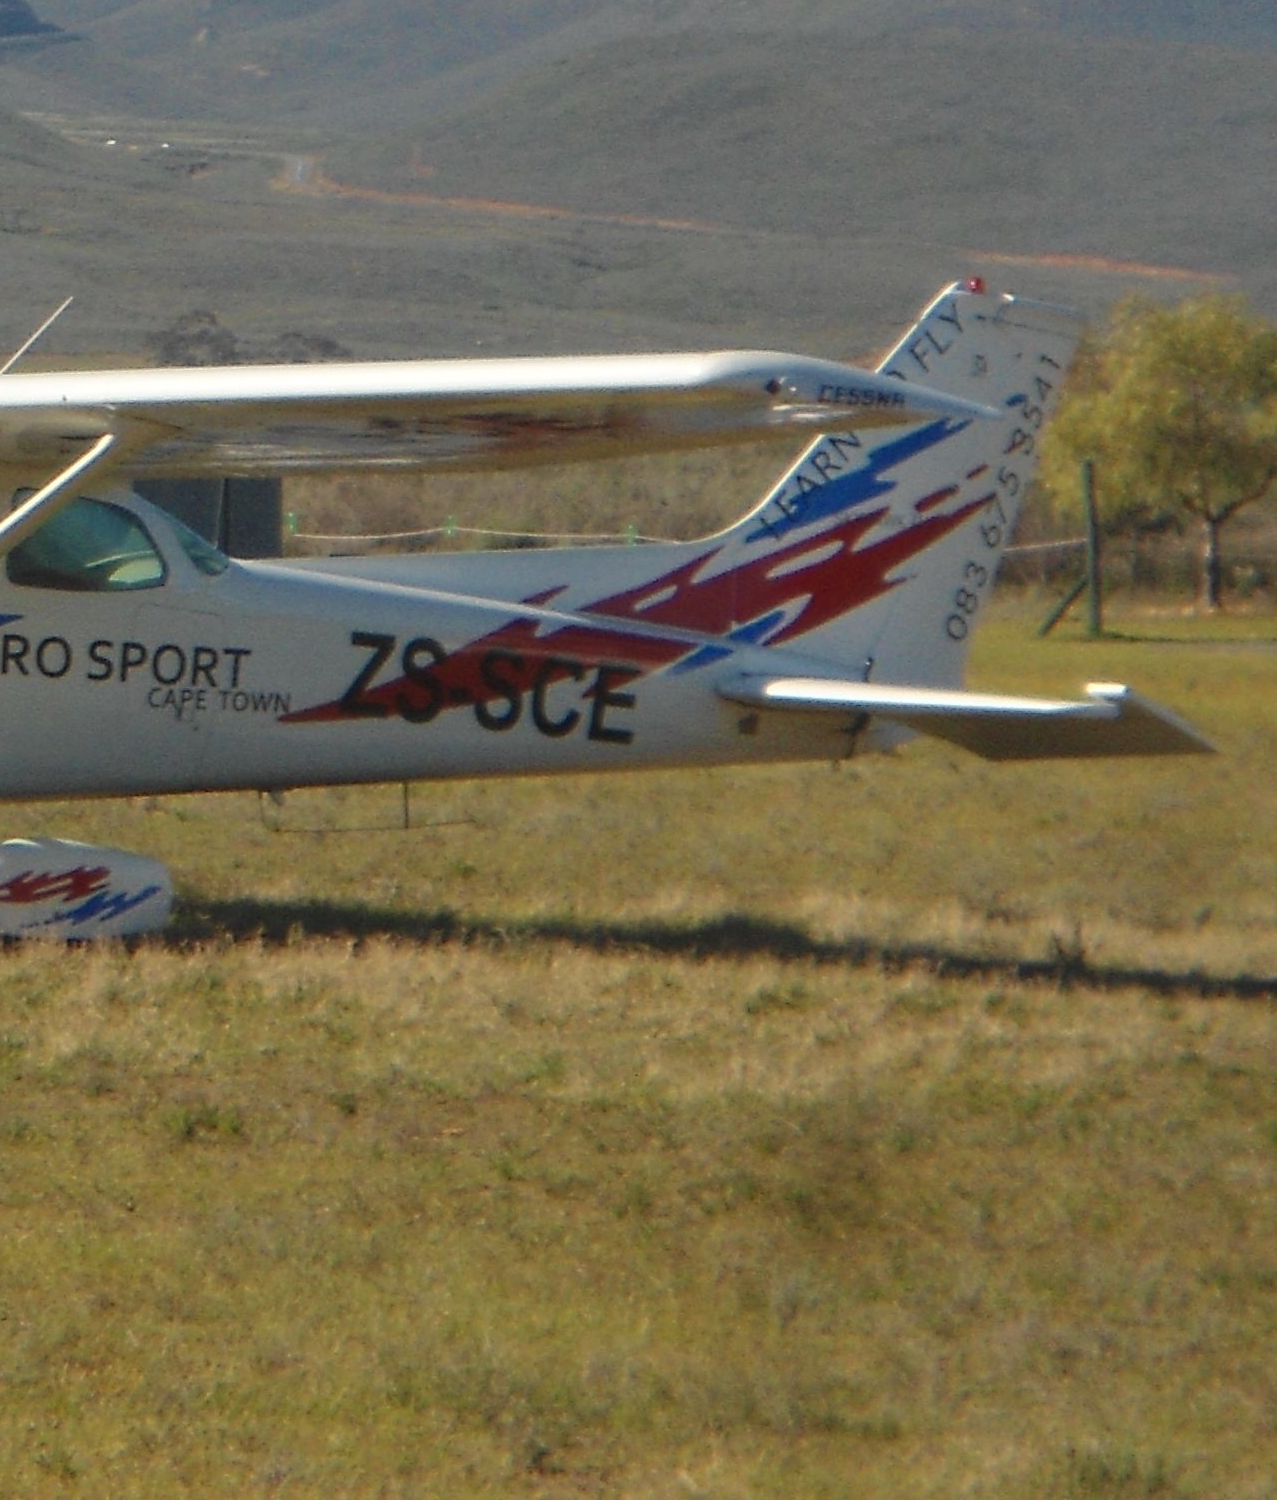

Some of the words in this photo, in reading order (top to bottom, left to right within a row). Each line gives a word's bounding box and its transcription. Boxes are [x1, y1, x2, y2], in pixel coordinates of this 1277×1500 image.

[910, 301, 964, 373] FLY
[818, 383, 906, 407] CESSNA
[760, 429, 861, 541] LEARN
[946, 560, 988, 641] 083
[86, 639, 253, 688] SPORT
[339, 631, 642, 745] ZS-SCE
[147, 687, 208, 711] CAPE
[219, 690, 292, 714] TOWN
